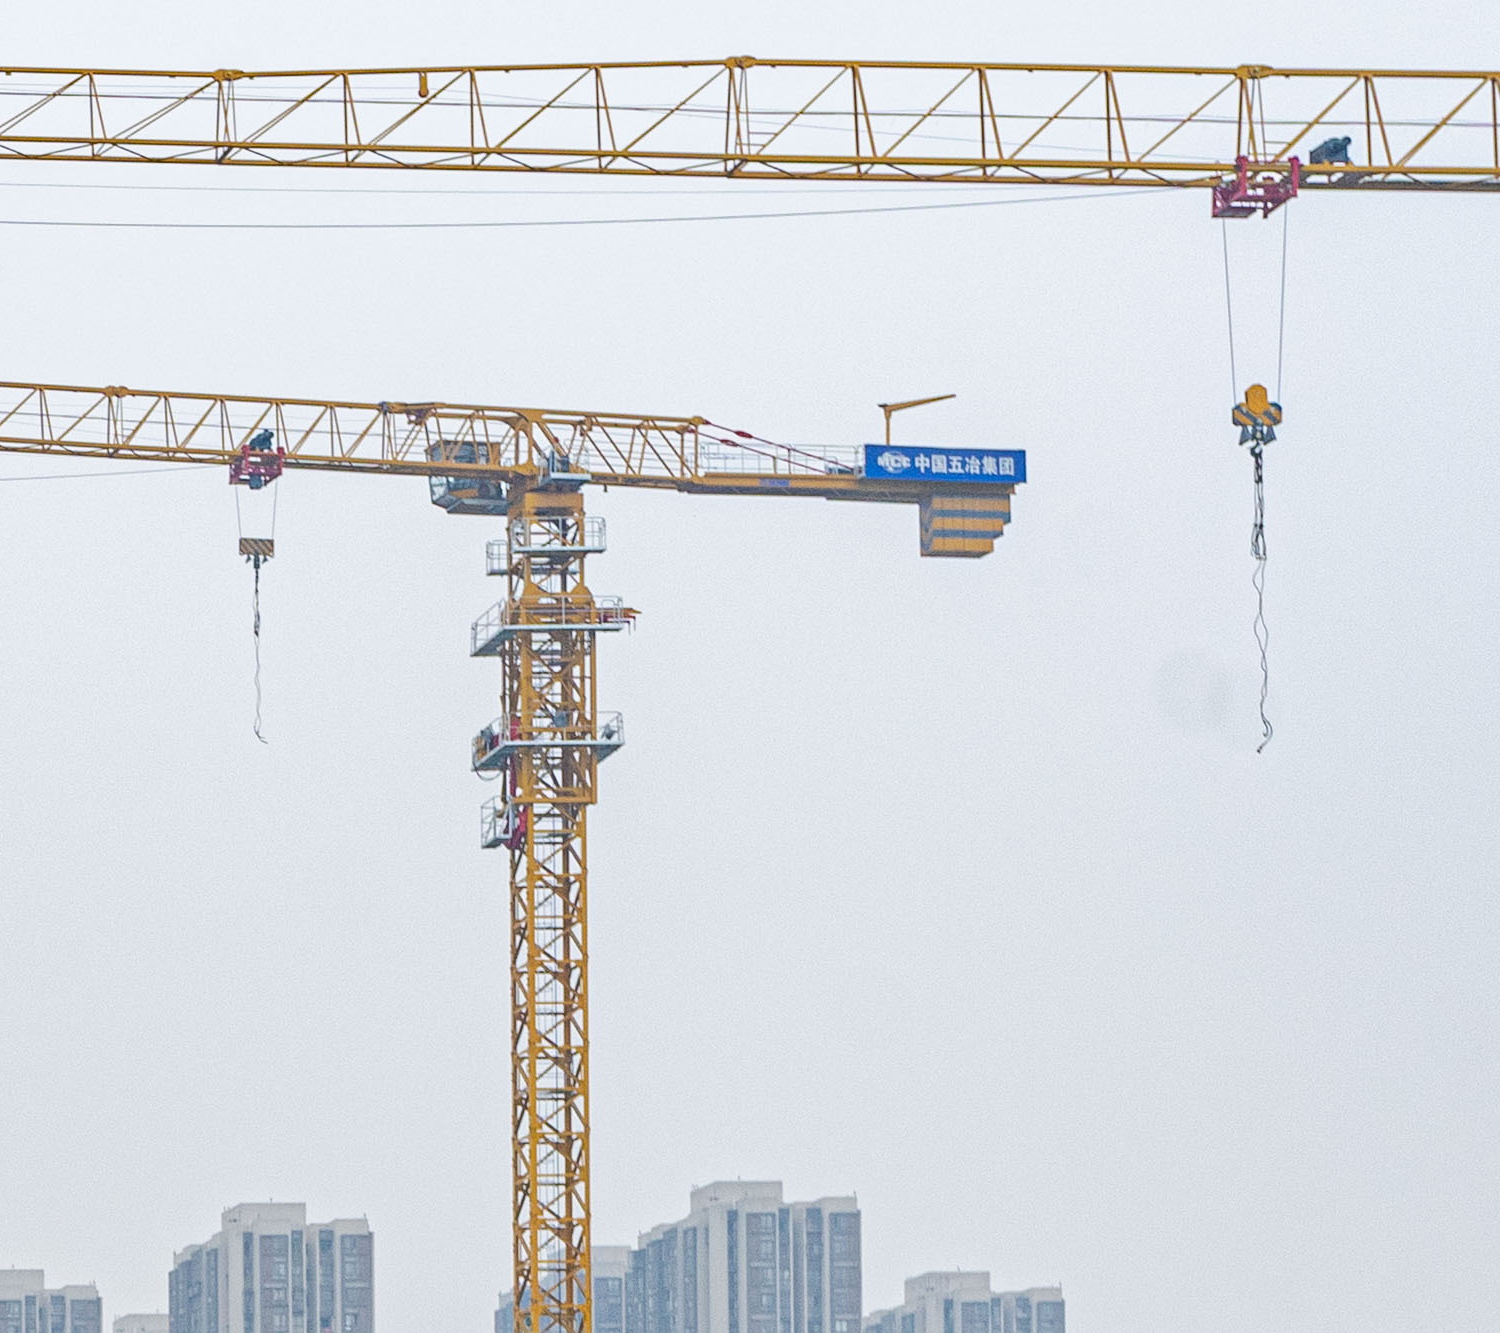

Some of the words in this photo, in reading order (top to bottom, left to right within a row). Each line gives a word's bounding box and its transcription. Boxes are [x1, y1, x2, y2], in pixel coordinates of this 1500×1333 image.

[915, 453, 1015, 476] 中国五冶集团
